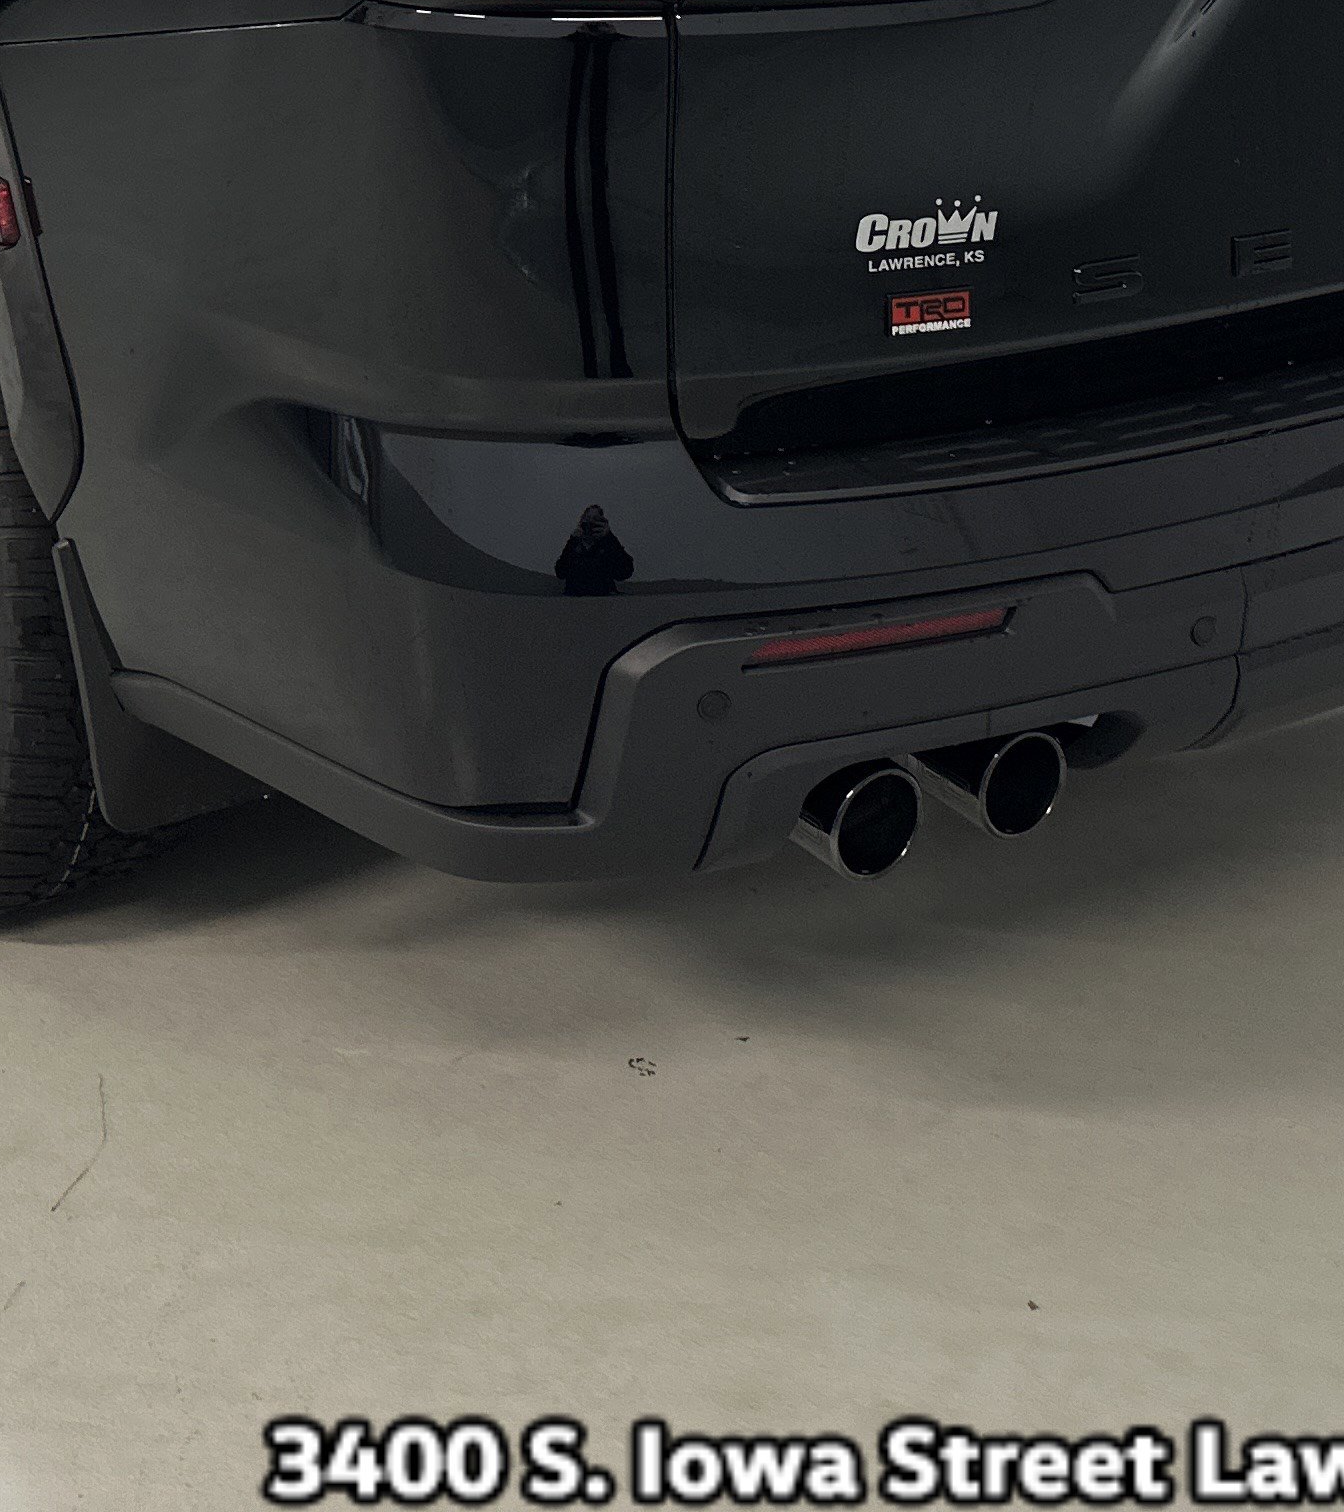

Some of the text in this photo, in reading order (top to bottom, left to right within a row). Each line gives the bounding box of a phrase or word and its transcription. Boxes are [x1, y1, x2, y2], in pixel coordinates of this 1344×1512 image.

[868, 249, 985, 273] LAWRENCE, KS
[895, 296, 966, 320] TRD
[891, 318, 971, 336] PERFORMANCE
